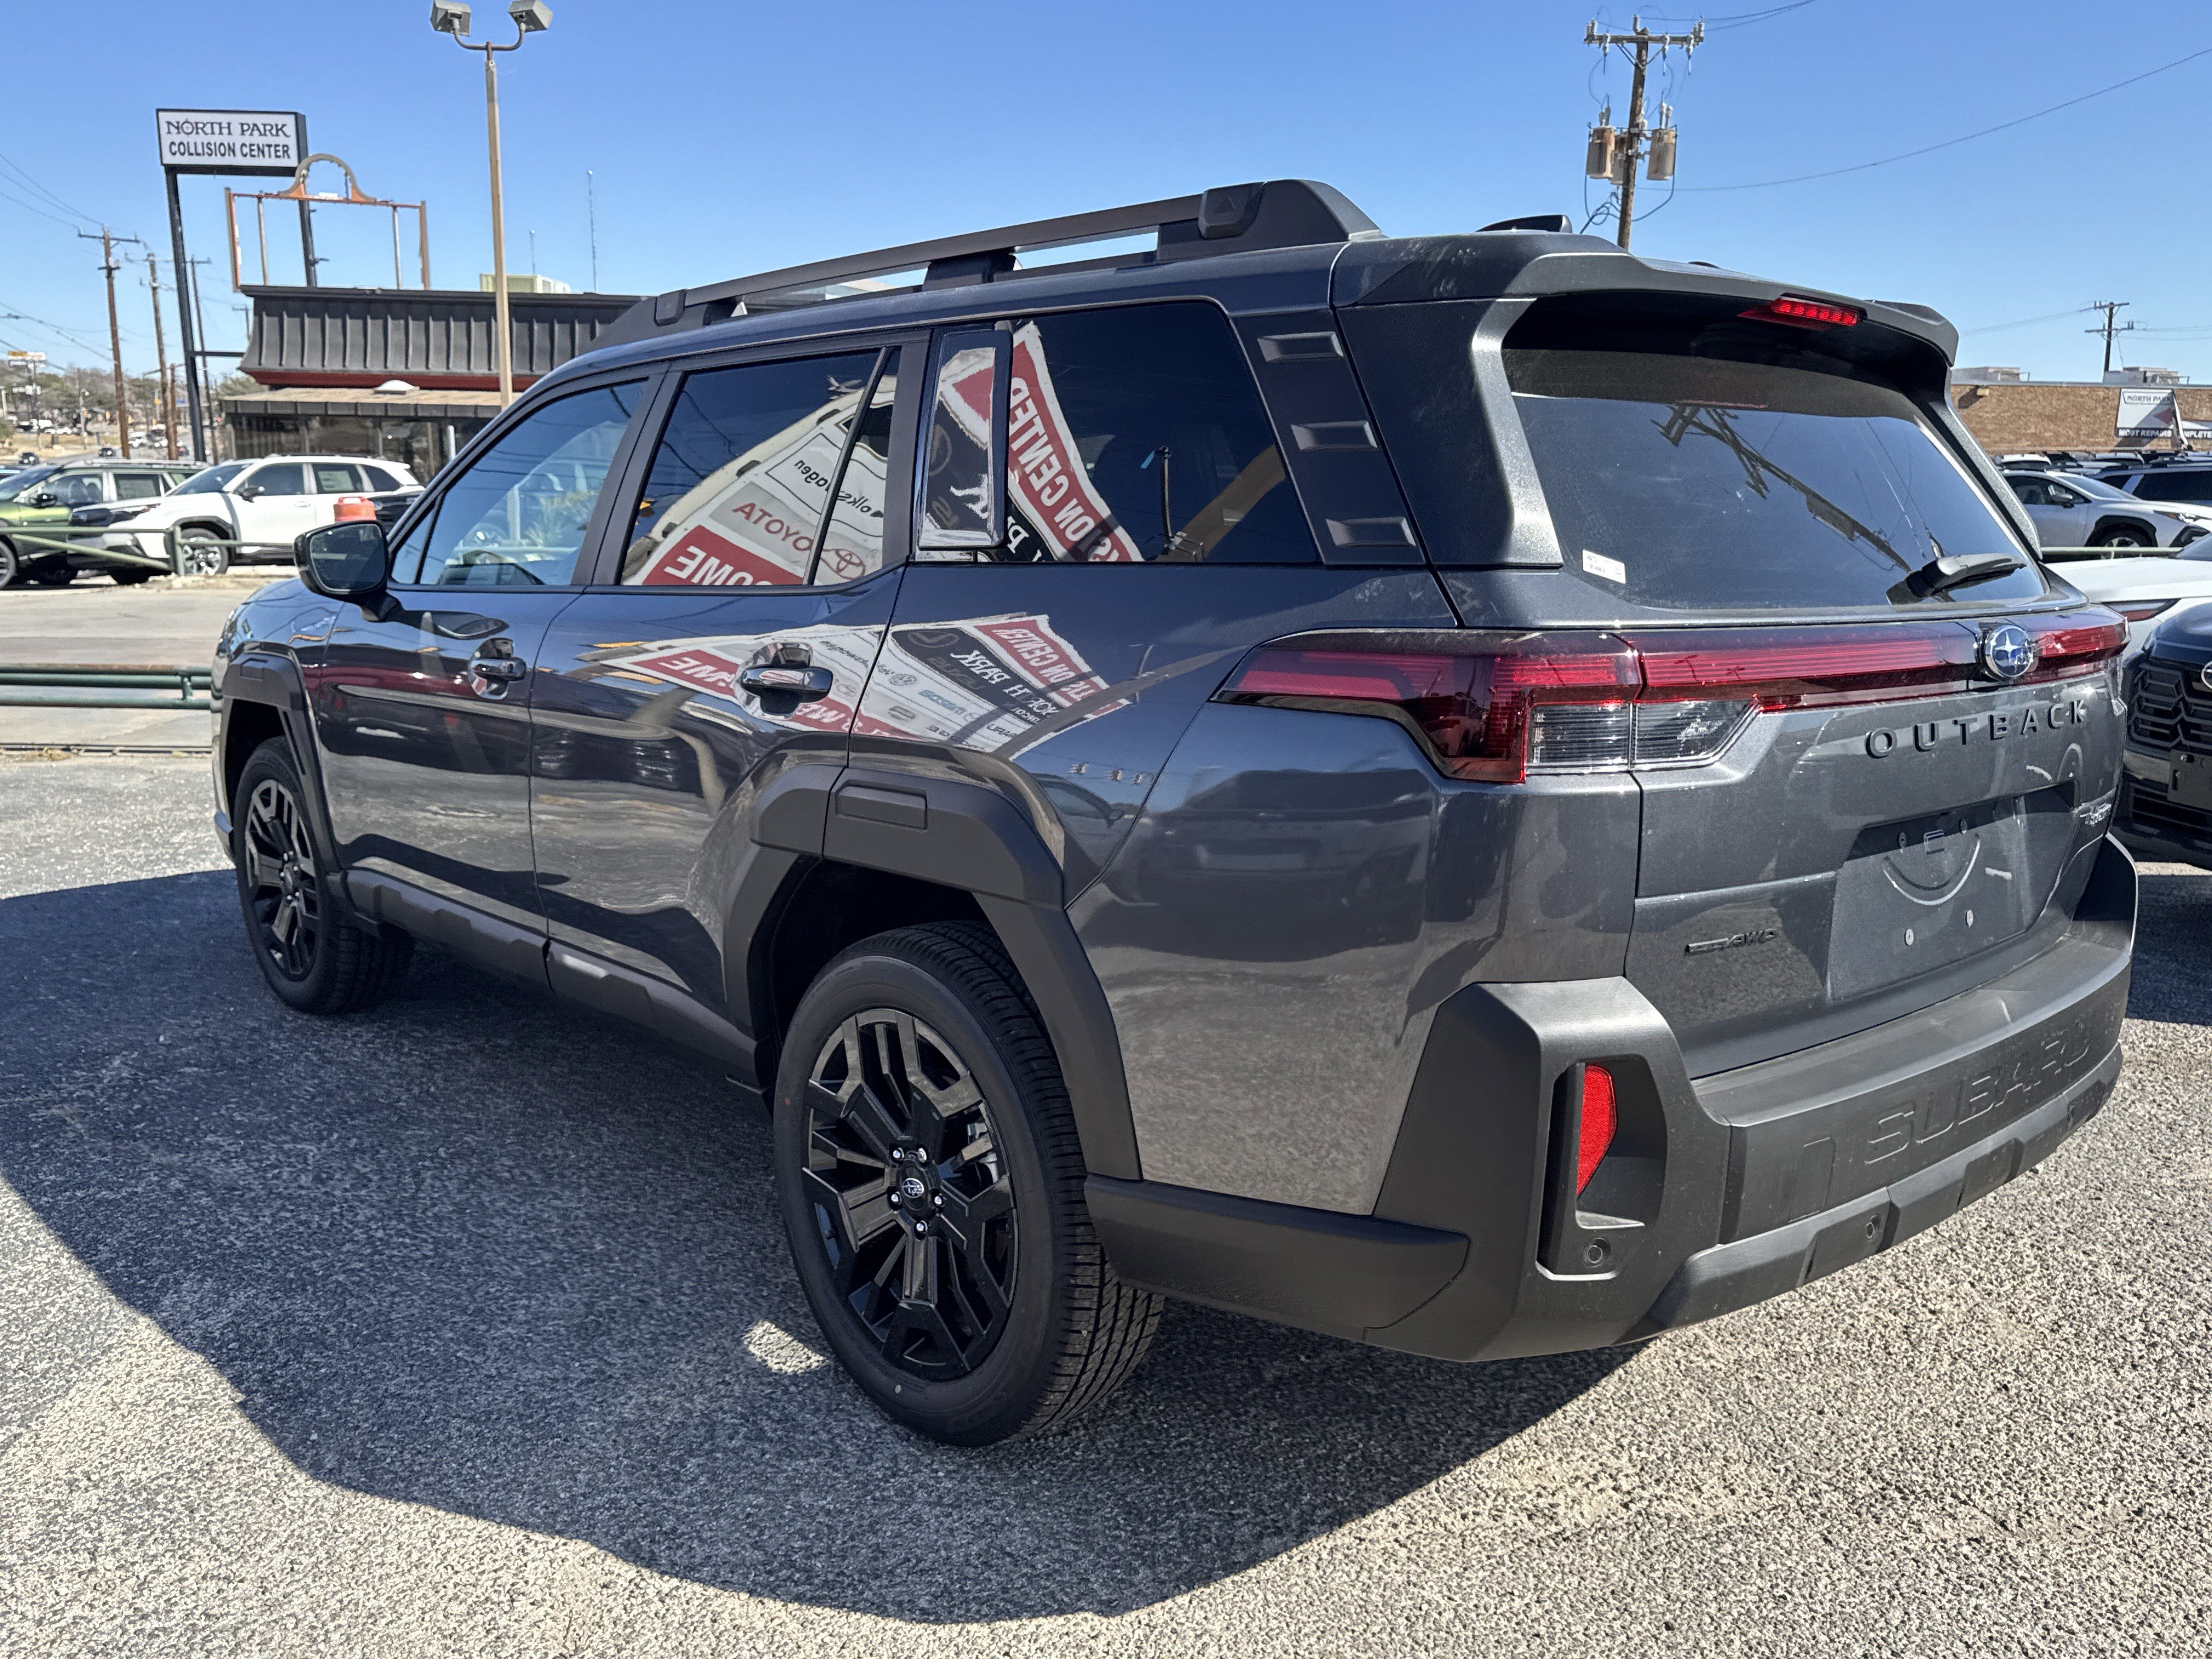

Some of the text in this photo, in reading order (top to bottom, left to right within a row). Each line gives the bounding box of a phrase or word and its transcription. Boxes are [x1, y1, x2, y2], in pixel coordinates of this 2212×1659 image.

[165, 120, 291, 138] NORTH PARK
[168, 141, 291, 159] COLLISION CENTER
[2118, 428, 2140, 437] MOST
[2140, 429, 2172, 438] REPAIRS
[1865, 699, 2088, 760] OUTBACK
[1863, 1027, 2091, 1165] SUBARU
